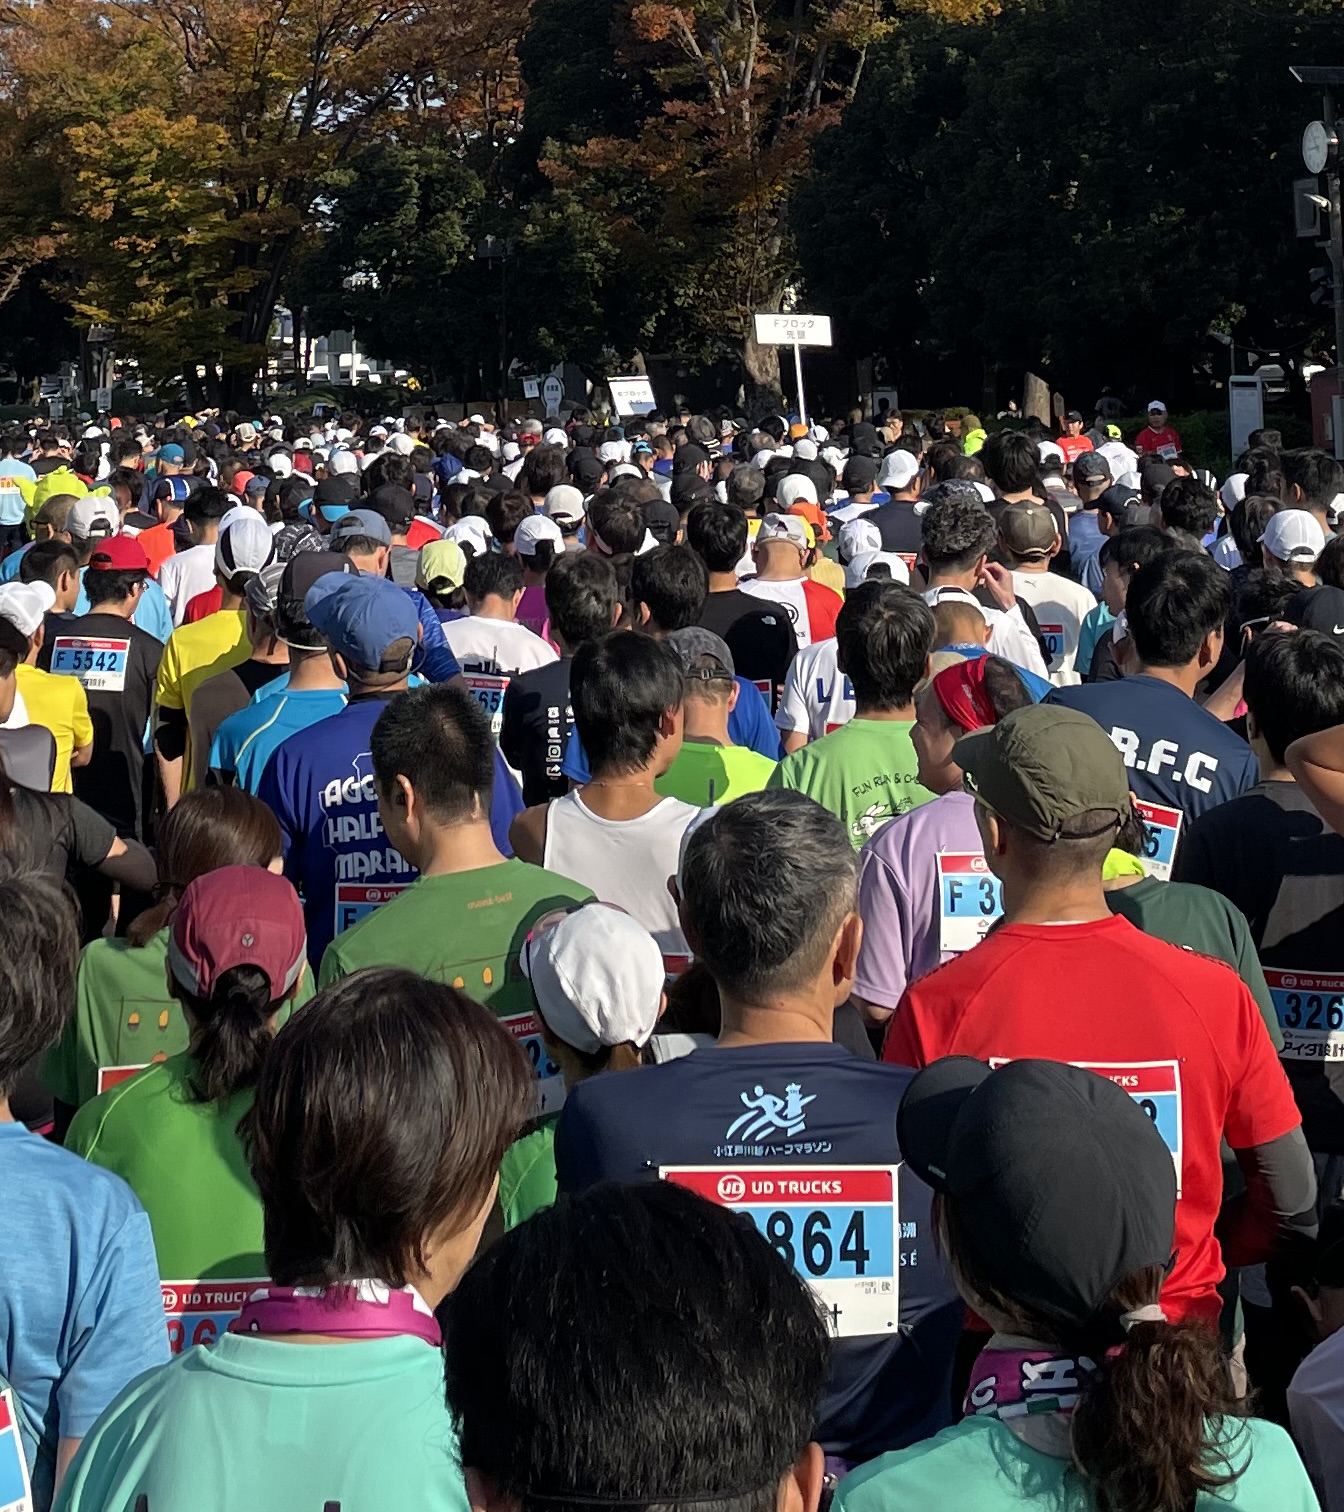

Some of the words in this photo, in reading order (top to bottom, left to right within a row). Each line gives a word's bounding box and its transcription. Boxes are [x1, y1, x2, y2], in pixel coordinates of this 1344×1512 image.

[56, 651, 67, 668] F
[72, 651, 117, 671] 5542
[325, 774, 379, 807] AGE
[949, 880, 963, 913] F
[751, 1181, 774, 1194] UD
[777, 1180, 843, 1194] TRUCKS
[182, 1293, 201, 1305] UD
